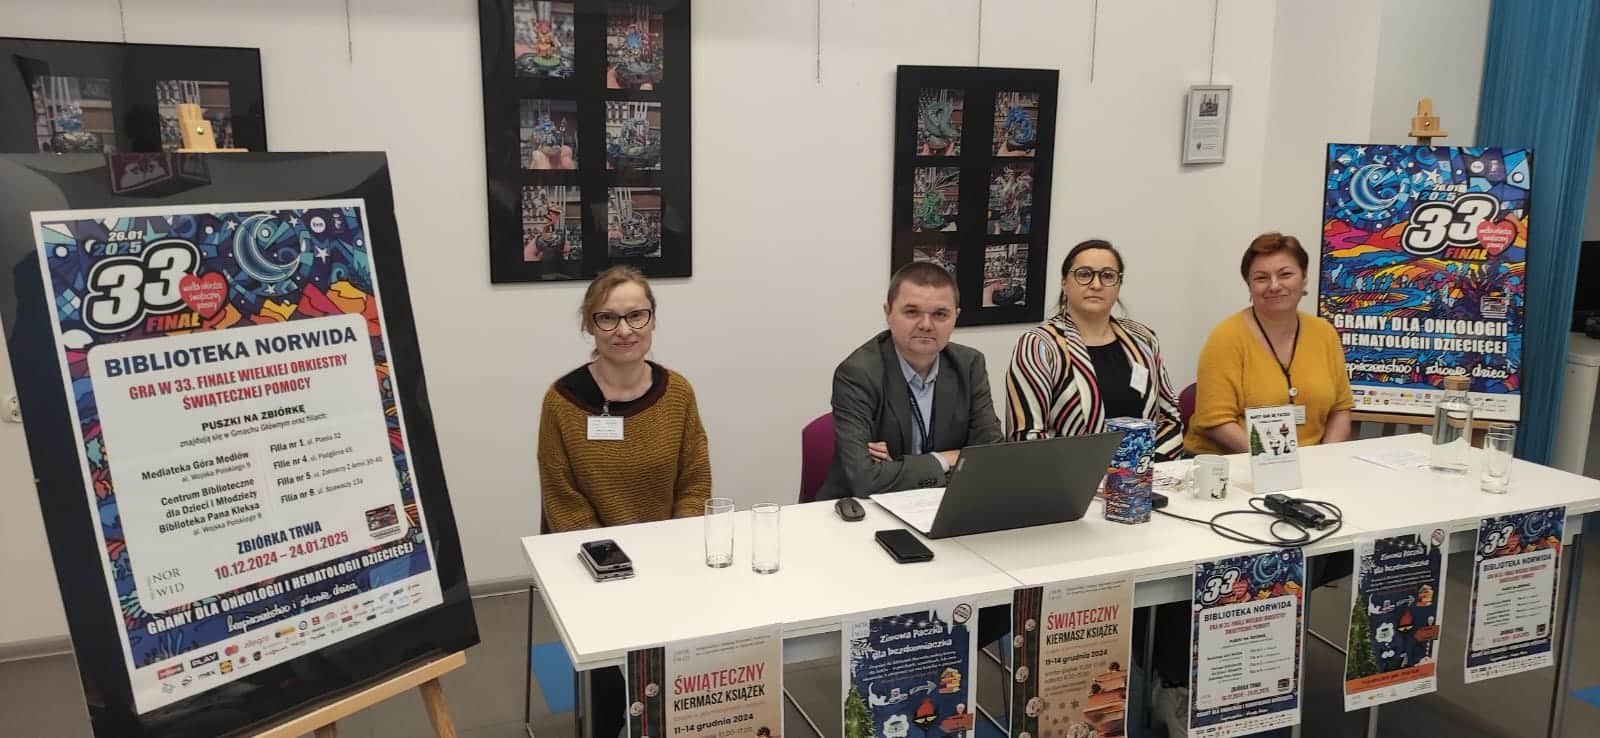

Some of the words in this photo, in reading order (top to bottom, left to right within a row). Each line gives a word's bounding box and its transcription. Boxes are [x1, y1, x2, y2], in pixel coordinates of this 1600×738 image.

[108, 230, 143, 242] 26.01
[1404, 195, 1497, 254] 33
[93, 242, 142, 256] 2025
[85, 241, 198, 331] 33
[1333, 313, 1388, 331] GRAMY
[1392, 317, 1420, 333] DLA
[1424, 319, 1508, 337] ONKOLOGII
[104, 341, 250, 378] BIBLIOTEKA
[255, 326, 357, 357] NORWIDA
[1342, 332, 1430, 350] HEMATOLOGII
[1434, 337, 1507, 354] DZIECIĘCEJ
[129, 382, 156, 400] GRA
[158, 381, 172, 396] W
[175, 378, 196, 393] 33.
[198, 371, 237, 389] FINALE
[238, 362, 289, 384] WIELKIEJ
[290, 353, 348, 375] ORKIESTRY
[1472, 362, 1509, 380] dzieci
[183, 387, 263, 411] ŚWIĄTECZNEJ
[265, 377, 311, 398] POMOCY
[201, 416, 241, 432] PUSZKI
[243, 414, 259, 424] NA
[261, 404, 306, 420] ZBIÓRKĘ
[141, 464, 191, 480] Mediateka
[193, 459, 214, 470] Góra
[215, 452, 249, 465] Mediów
[160, 491, 201, 506] Centrum
[201, 478, 255, 497] Biblioteczne
[166, 509, 181, 519] dla
[182, 501, 210, 515] Dzieci
[215, 490, 257, 506] Młodzieży
[159, 514, 206, 534] Biblioteka
[207, 509, 230, 521] Pana
[231, 502, 261, 516] Kleksa
[236, 530, 288, 554] ZBIÓRKA
[289, 520, 323, 541] TRWA
[1484, 525, 1513, 554] 33
[214, 551, 279, 580] 10.12.2024
[289, 530, 349, 559] 24.01.2025
[147, 610, 193, 635] GRAMY
[195, 602, 220, 620] DLA
[220, 583, 284, 612] ONKOLOGII
[284, 579, 291, 592] I
[292, 558, 361, 589] HEMATOLOGII
[361, 541, 414, 568] DZIECIĘCEJ
[151, 567, 181, 584] NOR
[1202, 568, 1240, 604] 33
[156, 583, 185, 598] WID
[1047, 604, 1119, 631] ŚWIĄTECZNY
[1204, 608, 1252, 622] BIBLIOTEKA
[1254, 600, 1292, 614] NORWIDA
[1046, 629, 1085, 646] KIERMASZ
[1086, 623, 1119, 640] KSIĄŻEK
[674, 662, 765, 696] ŚWIĄTECZNY
[674, 691, 723, 712] KIERMASZ
[725, 684, 765, 703] KSIĄŻEK
[696, 718, 732, 732] grudnia
